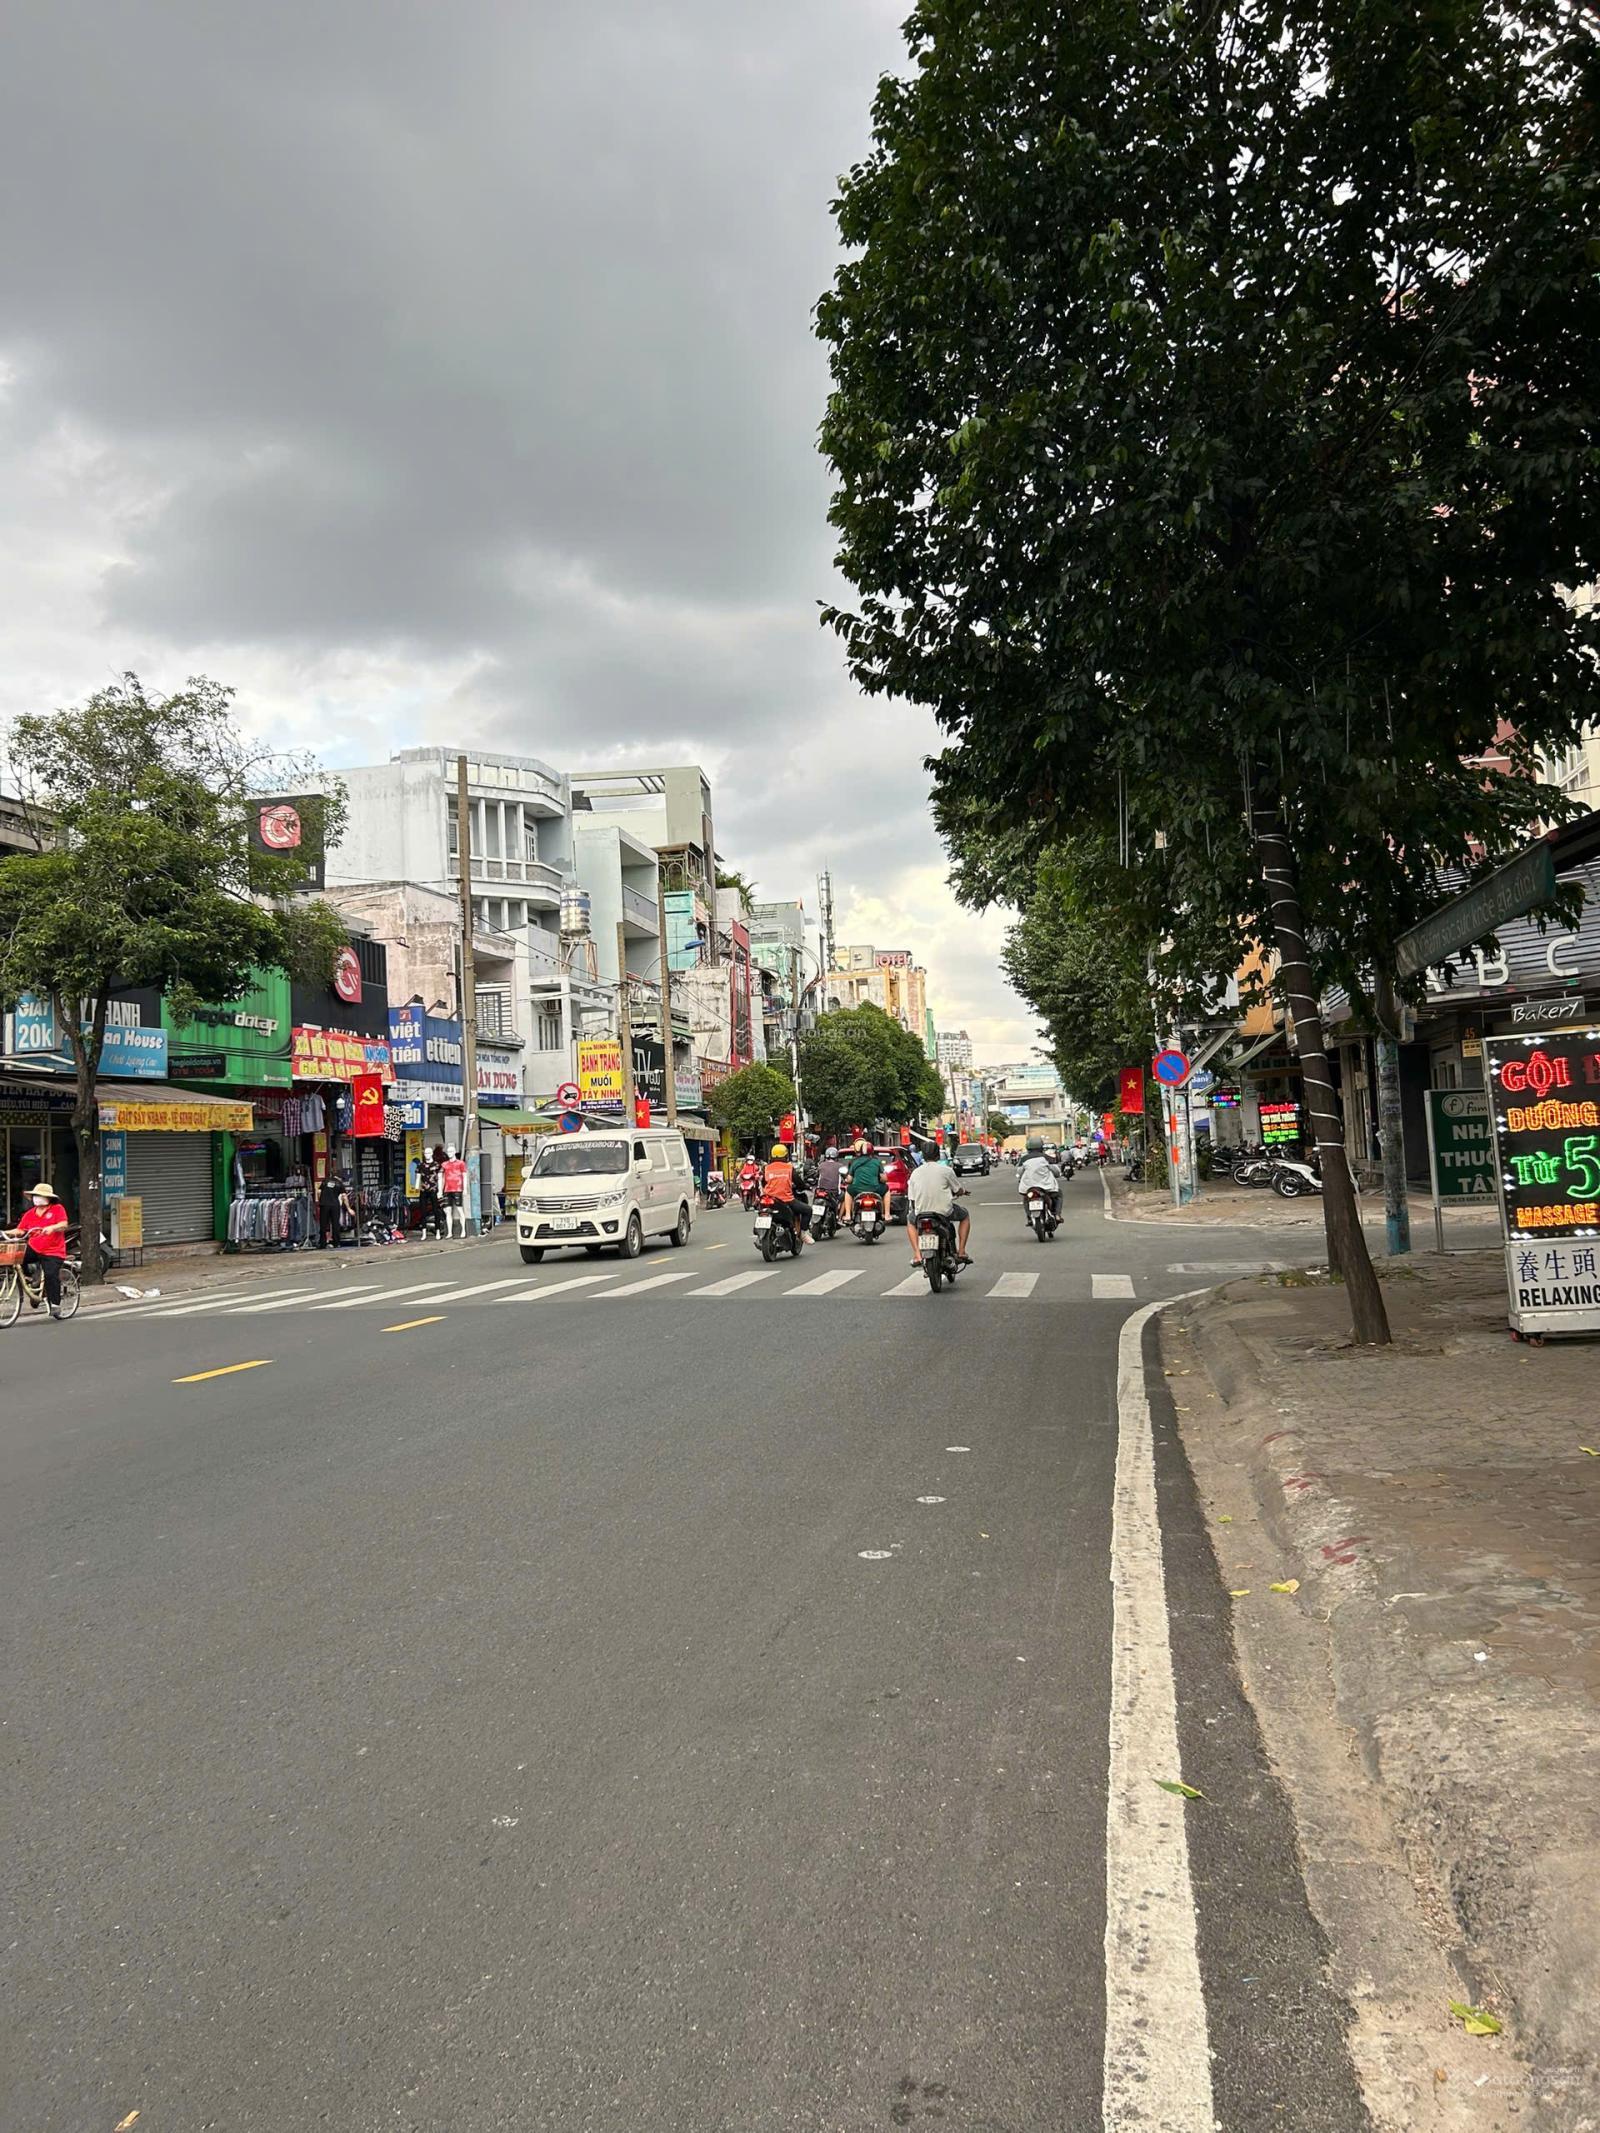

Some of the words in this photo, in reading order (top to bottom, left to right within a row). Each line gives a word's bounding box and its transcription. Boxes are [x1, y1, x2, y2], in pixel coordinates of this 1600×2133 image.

[1512, 1001, 1579, 1023] Bakery
[18, 1023, 52, 1048] 20k
[124, 1030, 164, 1049] House
[389, 1021, 421, 1042] việt
[391, 1044, 421, 1063] tiến
[591, 1073, 612, 1086] MUỐI
[1501, 1051, 1572, 1097] GỘI
[601, 1088, 621, 1099] NINH
[1516, 1202, 1600, 1228] MASSAGE
[1516, 1247, 1598, 1283] 養生頭
